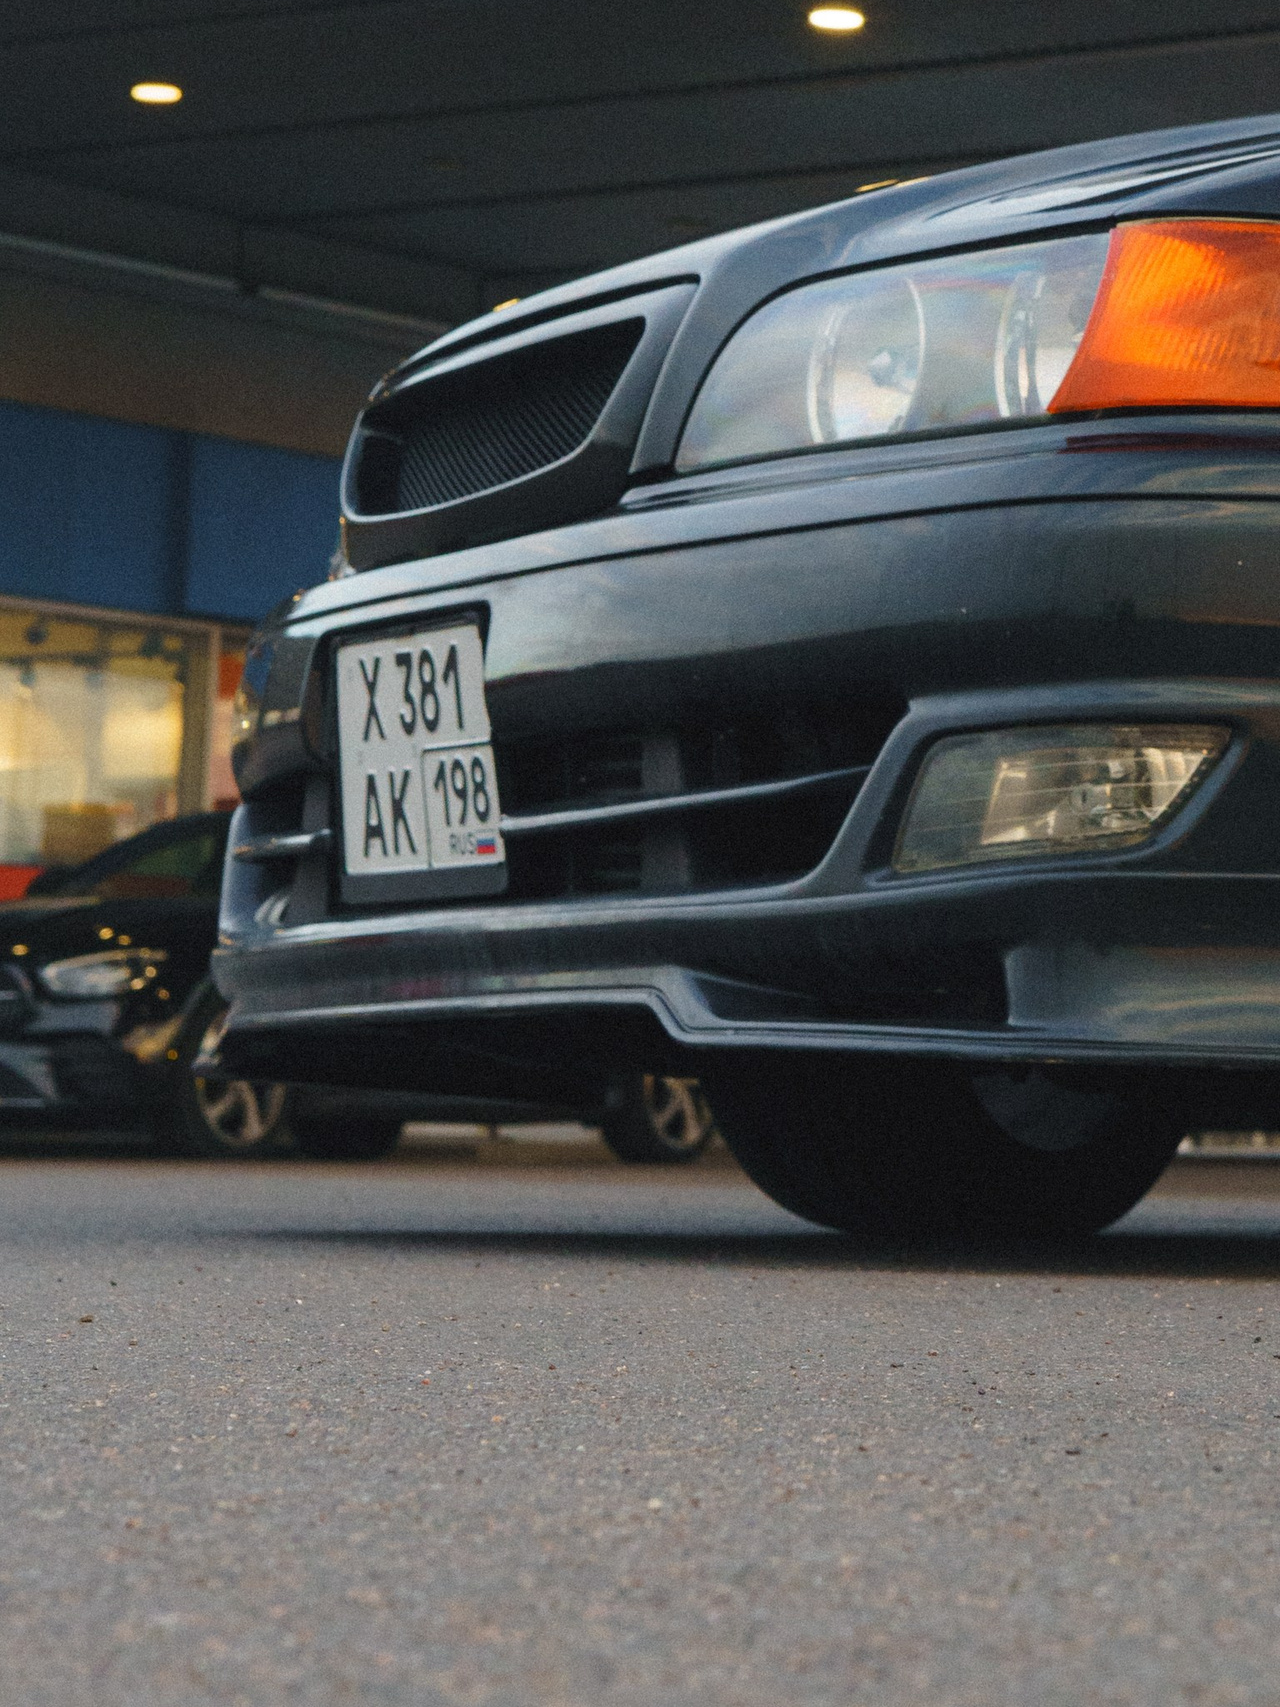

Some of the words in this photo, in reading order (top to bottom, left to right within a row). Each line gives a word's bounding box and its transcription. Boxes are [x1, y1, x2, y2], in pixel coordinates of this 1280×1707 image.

[395, 644, 465, 735] 381
[364, 769, 417, 858] AK
[434, 756, 490, 827] 198
[449, 833, 476, 855] RUS
